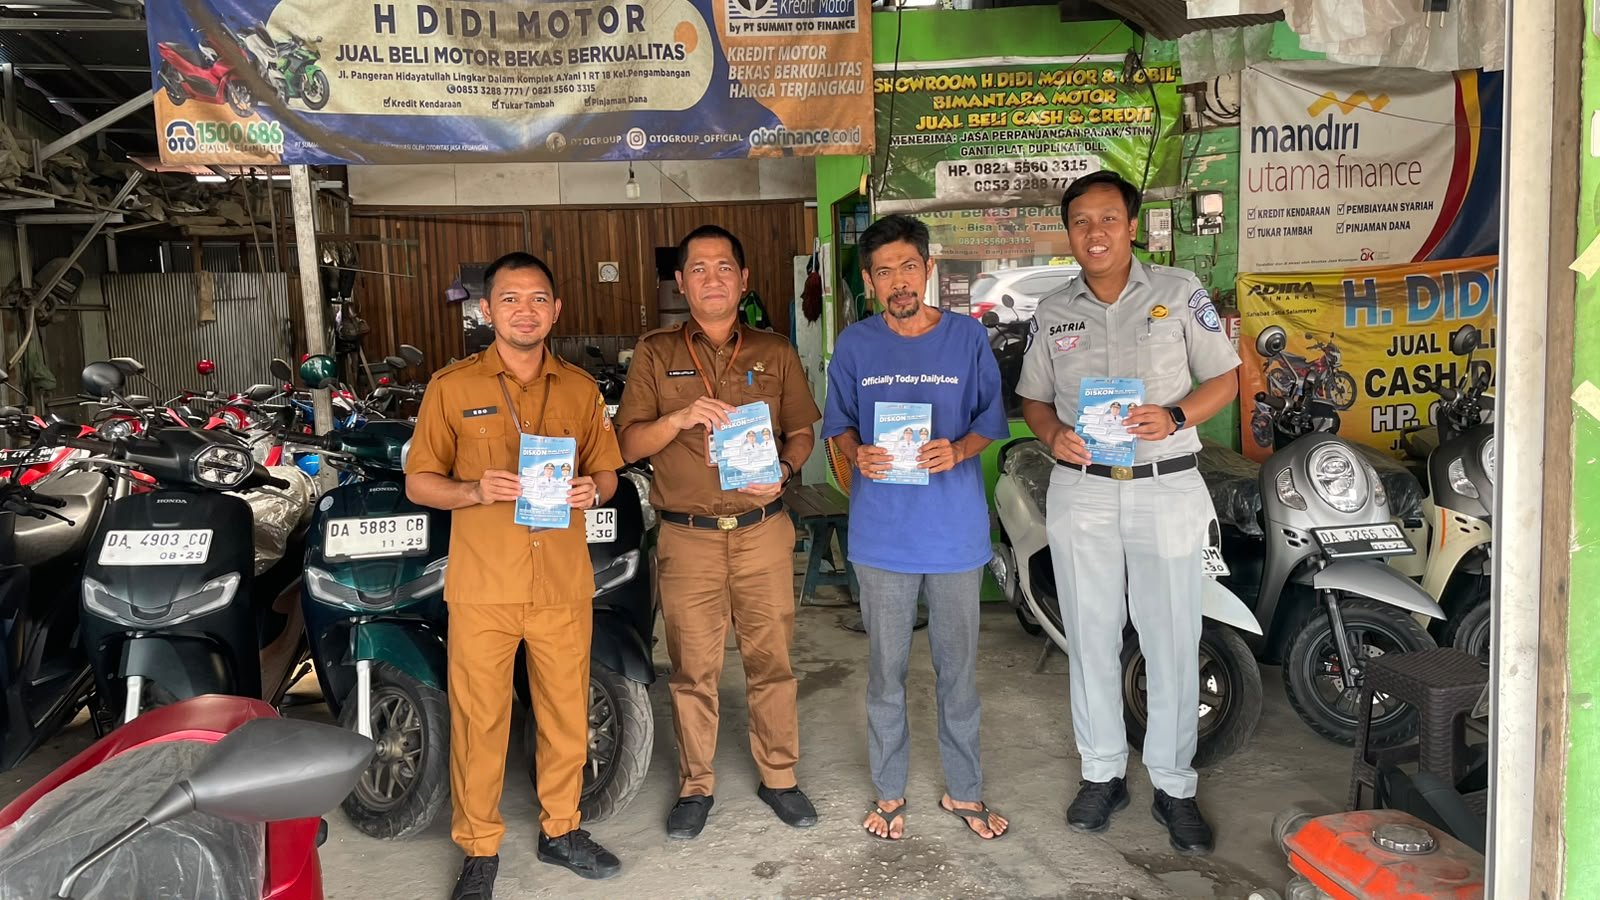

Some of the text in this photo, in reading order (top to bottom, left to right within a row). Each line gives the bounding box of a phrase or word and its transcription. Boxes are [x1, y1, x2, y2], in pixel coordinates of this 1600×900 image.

[780, 0, 852, 15] Kredit Motor
[374, 4, 646, 39] H DIDI MOTOR
[729, 20, 856, 34] by PT SUMMIT OTO FINANCE
[336, 43, 686, 67] JUAL BELI MOTOR BEKAS BERKUALITAS
[727, 45, 827, 62] KREDIT MOTOR
[351, 71, 394, 82] Pangeran
[395, 72, 451, 83] Hidayatullah
[453, 73, 485, 84] Lingkar
[488, 74, 515, 84] Dalam
[517, 72, 554, 84] Komplek
[556, 73, 581, 82] A.Yani
[589, 71, 600, 80] RT
[602, 71, 611, 80] 18
[613, 68, 691, 80] Kel.Pengambangan
[728, 62, 862, 81] BEKAS BERKUALITAS
[874, 66, 1176, 94] SHOWROOM H.DIDI MOTOR & OBIL
[456, 84, 596, 97] 0853 3288 7771 / 0821 5560 3315
[729, 80, 865, 100] HARGA TERJANGKAU
[391, 99, 462, 109] Kredit Kendaraan
[500, 100, 555, 110] Tukar Tambah
[591, 95, 648, 107] Pinjaman Dana
[933, 89, 1117, 110] BIMANTARA MOTOR
[915, 106, 1153, 131] JUAL BELI CASH & CREDIT
[196, 121, 282, 145] 1500 686
[649, 133, 744, 145] OTOGROUP_OFFICIAL
[891, 126, 1153, 146] MENERIMA: JASA PERPANJANGAN PAJAK/STNK
[1251, 113, 1360, 153] mandiri
[168, 137, 196, 152] OTO
[199, 144, 284, 153] CALL CENTER
[960, 145, 993, 157] GANTI
[1029, 143, 1082, 154] DUPLIKAT
[1085, 142, 1107, 152] DLL.
[948, 159, 1088, 177] HP. 0821 5560 3315
[1248, 153, 1423, 194] utama finance
[974, 180, 1010, 192] 0853
[1013, 178, 1048, 191] 3288
[1257, 206, 1331, 219] KREDIT KENDARAAN
[1346, 201, 1434, 215] PEMBIAYAAN SYARIAH
[967, 223, 992, 232] Bisa
[1033, 222, 1067, 232] Tamb
[1257, 225, 1313, 238] TUKAR TAMBAH
[1345, 220, 1411, 233] PINJAMAN DANA
[1248, 281, 1315, 296] ADIRA
[1262, 294, 1317, 302] FINANCE
[1342, 277, 1394, 329] H.
[1286, 308, 1317, 316] Selamanya
[1049, 321, 1086, 336] SATRIA
[1387, 332, 1442, 357] JUAL
[861, 374, 960, 387] Officially Today DailyLook
[1364, 362, 1457, 399] CASH
[1084, 389, 1115, 397] DISKON
[720, 420, 748, 431] DISKON
[879, 415, 907, 423] DISKON
[1371, 403, 1421, 434] HP.
[596, 511, 613, 525] CR
[330, 518, 424, 537] DA 5883 CB
[1319, 531, 1340, 544] DA
[1382, 526, 1401, 539] CV
[107, 533, 128, 547] DA
[140, 533, 180, 547] 4903
[1202, 549, 1221, 560] JM
